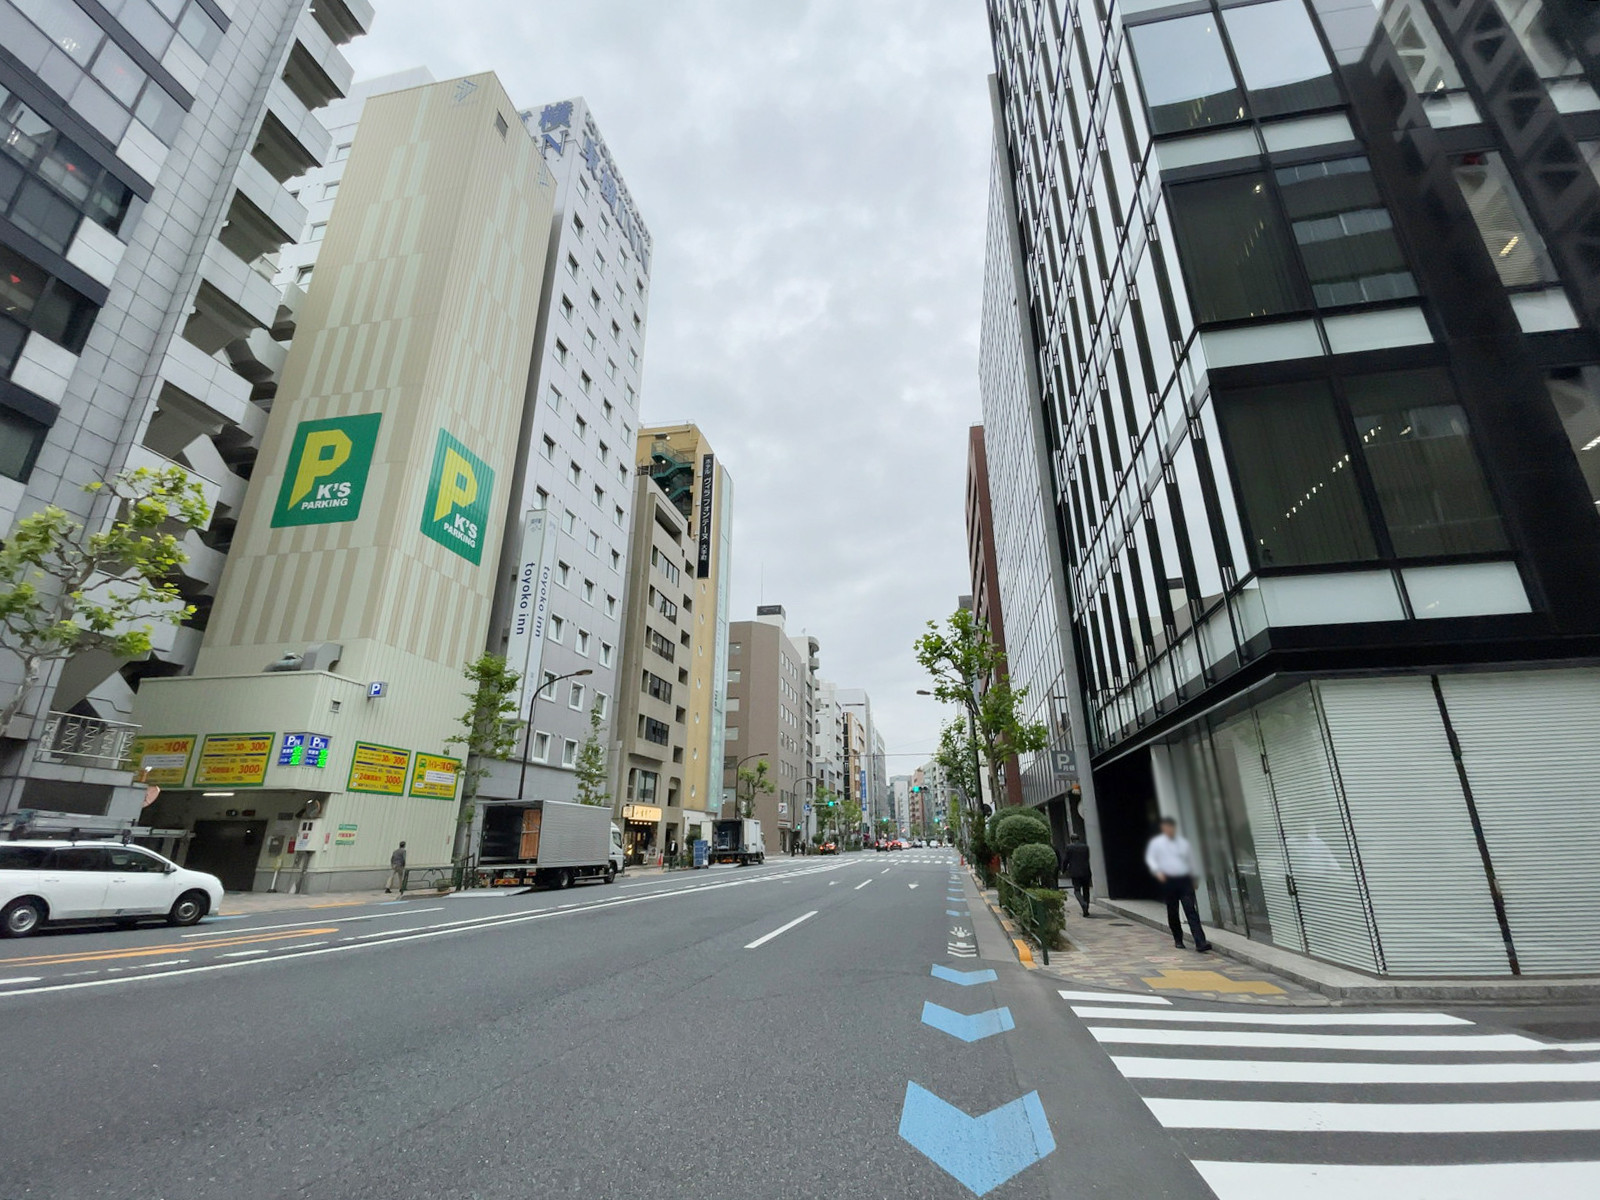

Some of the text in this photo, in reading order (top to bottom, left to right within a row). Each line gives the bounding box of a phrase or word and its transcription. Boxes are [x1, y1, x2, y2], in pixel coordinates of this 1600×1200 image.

[316, 482, 352, 500] K'S
[301, 498, 349, 510] PARKING
[443, 522, 477, 549] PARKING
[454, 513, 478, 540] K'S
[516, 562, 536, 635] toyoko inn
[535, 566, 551, 638] toyoko inn
[370, 683, 381, 695] P
[1056, 753, 1070, 770] P
